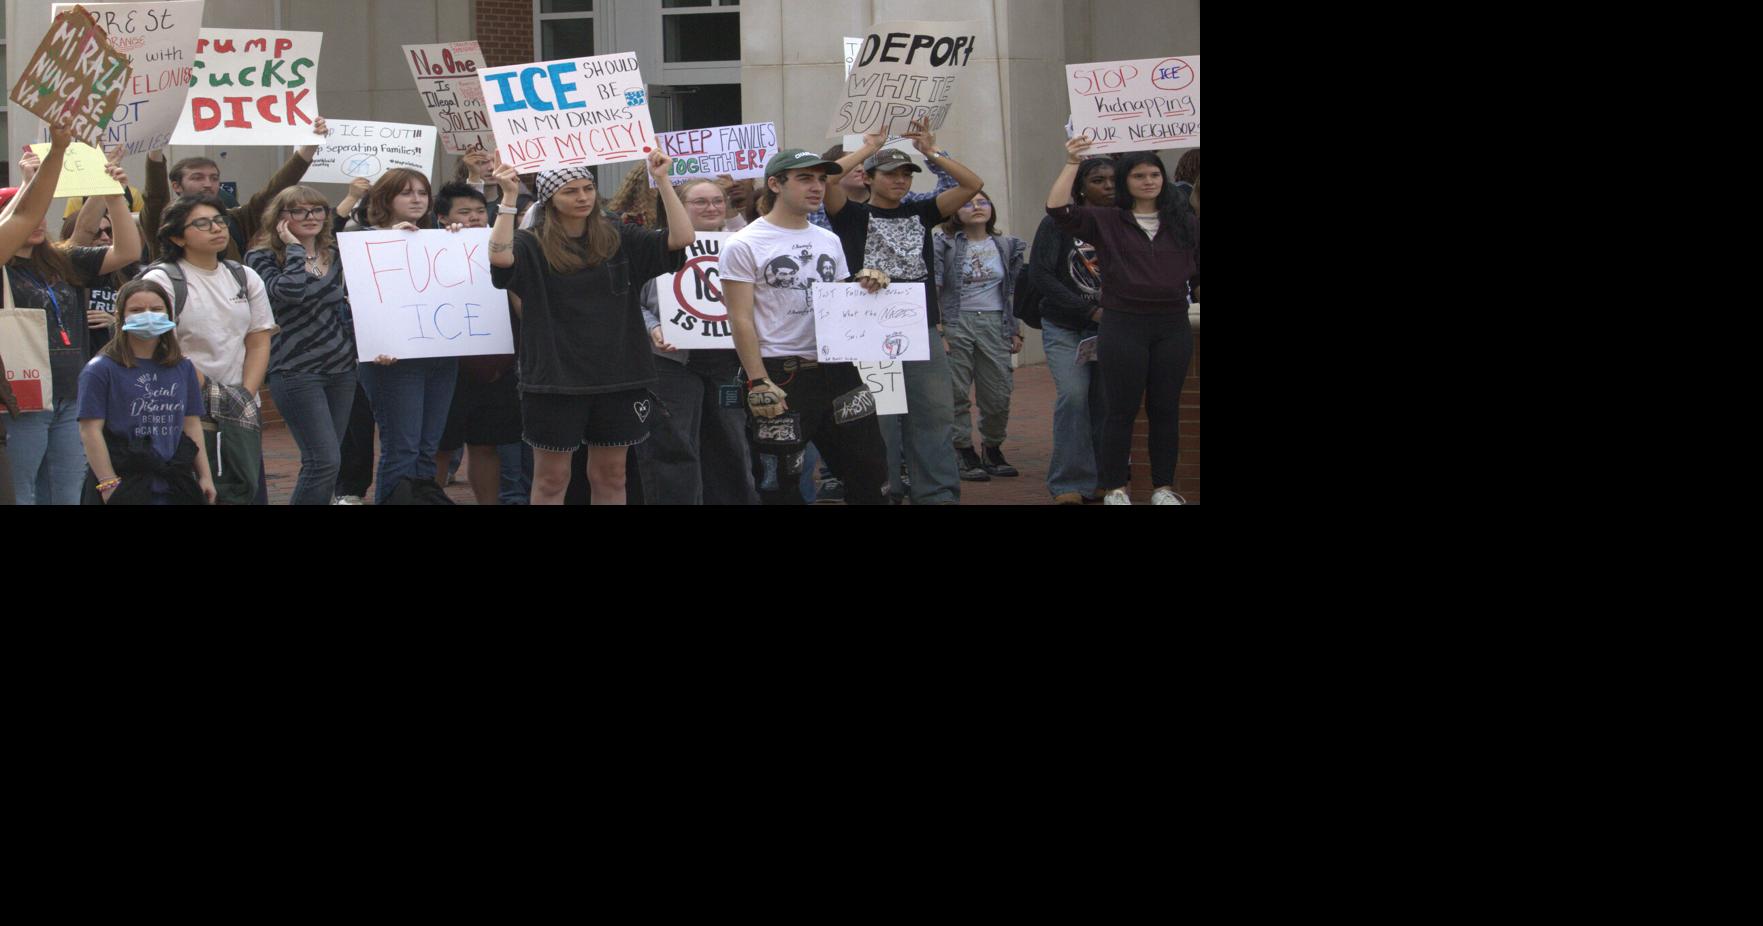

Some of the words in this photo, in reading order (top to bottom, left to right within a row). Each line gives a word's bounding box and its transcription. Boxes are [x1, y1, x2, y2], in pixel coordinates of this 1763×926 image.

[146, 46, 184, 62] with
[196, 38, 293, 58] rump
[410, 49, 443, 75] No
[442, 48, 476, 74] One
[30, 52, 83, 106] NUNCA
[75, 37, 129, 96] RAZA
[1073, 64, 1138, 95] STOP
[1159, 66, 1181, 80] ICE
[434, 80, 450, 92] Is
[484, 61, 587, 112] ICE
[583, 57, 640, 79] SHOULD
[597, 82, 621, 100] BE
[848, 73, 956, 103] WHITE
[111, 100, 149, 123] OT
[191, 88, 313, 132] DICK
[422, 91, 459, 115] Illegal
[464, 98, 480, 107] on
[340, 124, 373, 137] ICE
[439, 110, 488, 133] STOLEN
[507, 118, 528, 135] IN
[534, 113, 561, 131] MY
[566, 106, 633, 128] DRINKS
[1082, 126, 1120, 142] OUR
[326, 143, 378, 156] seperating
[507, 136, 547, 164] NOT
[554, 131, 587, 159] MY
[589, 120, 652, 153] CITY!
[664, 129, 712, 155] KEEP
[668, 149, 767, 176] TOGETHER!
[365, 239, 490, 303] FUCK
[693, 267, 722, 302] IC
[92, 290, 118, 301] FUC
[401, 303, 491, 341] ICE
[670, 308, 698, 331] IS
[701, 320, 732, 337] ILL
[23, 369, 40, 379] NO
